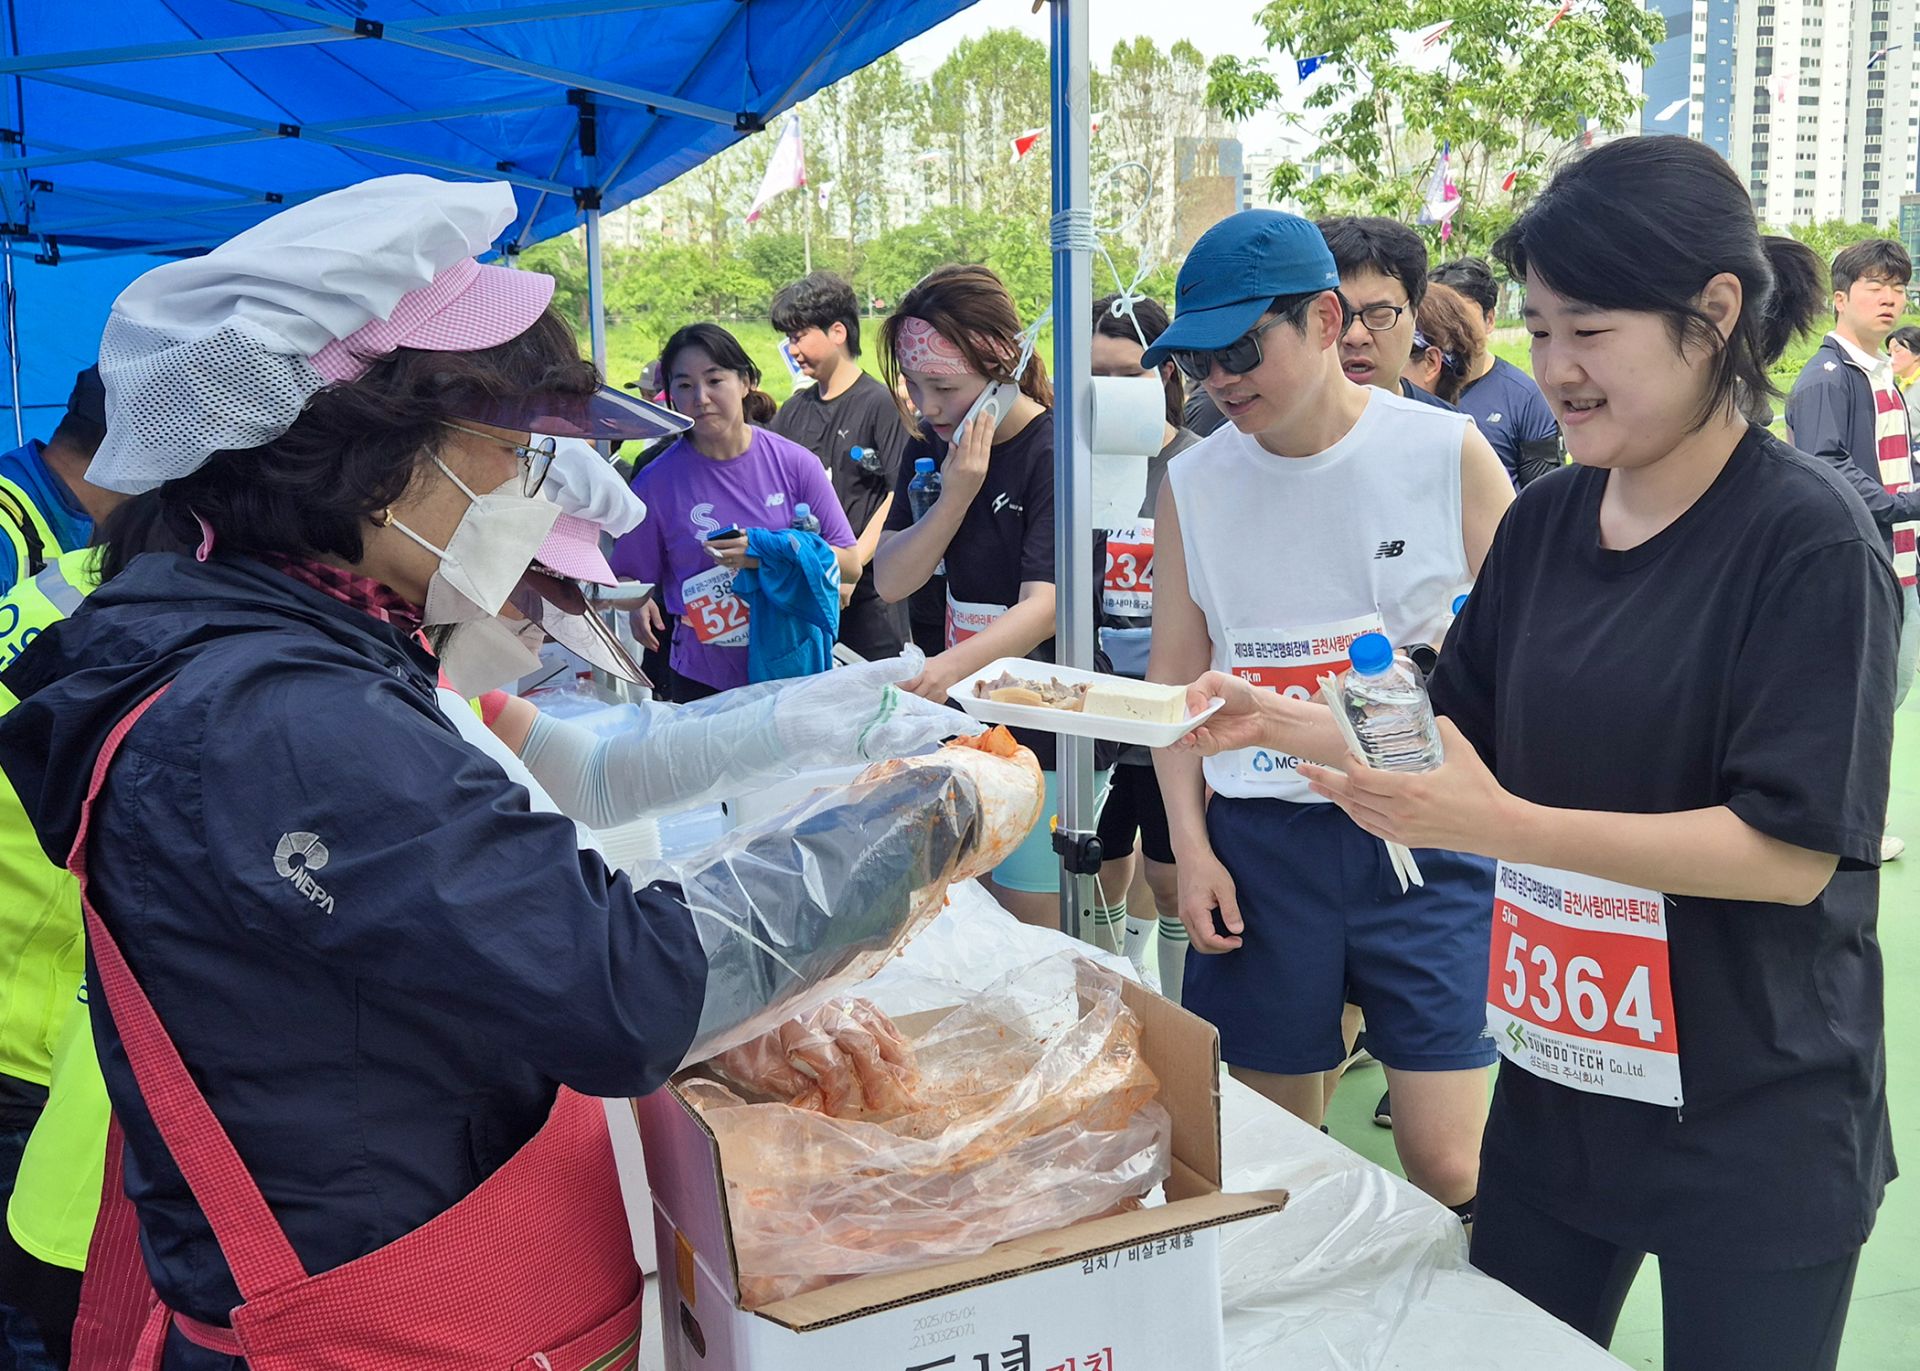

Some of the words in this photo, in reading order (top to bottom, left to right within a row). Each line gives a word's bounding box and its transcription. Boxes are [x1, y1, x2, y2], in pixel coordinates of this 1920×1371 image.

[701, 597, 747, 634] 52
[1563, 890, 1660, 926] 금천사랑마라톤대회
[1502, 931, 1663, 1042] 5364
[1562, 1066, 1604, 1087] 주식회사
[1572, 1051, 1604, 1071] TECH
[1082, 1254, 1108, 1275] 김치
[1128, 1231, 1194, 1262] 비살균제품
